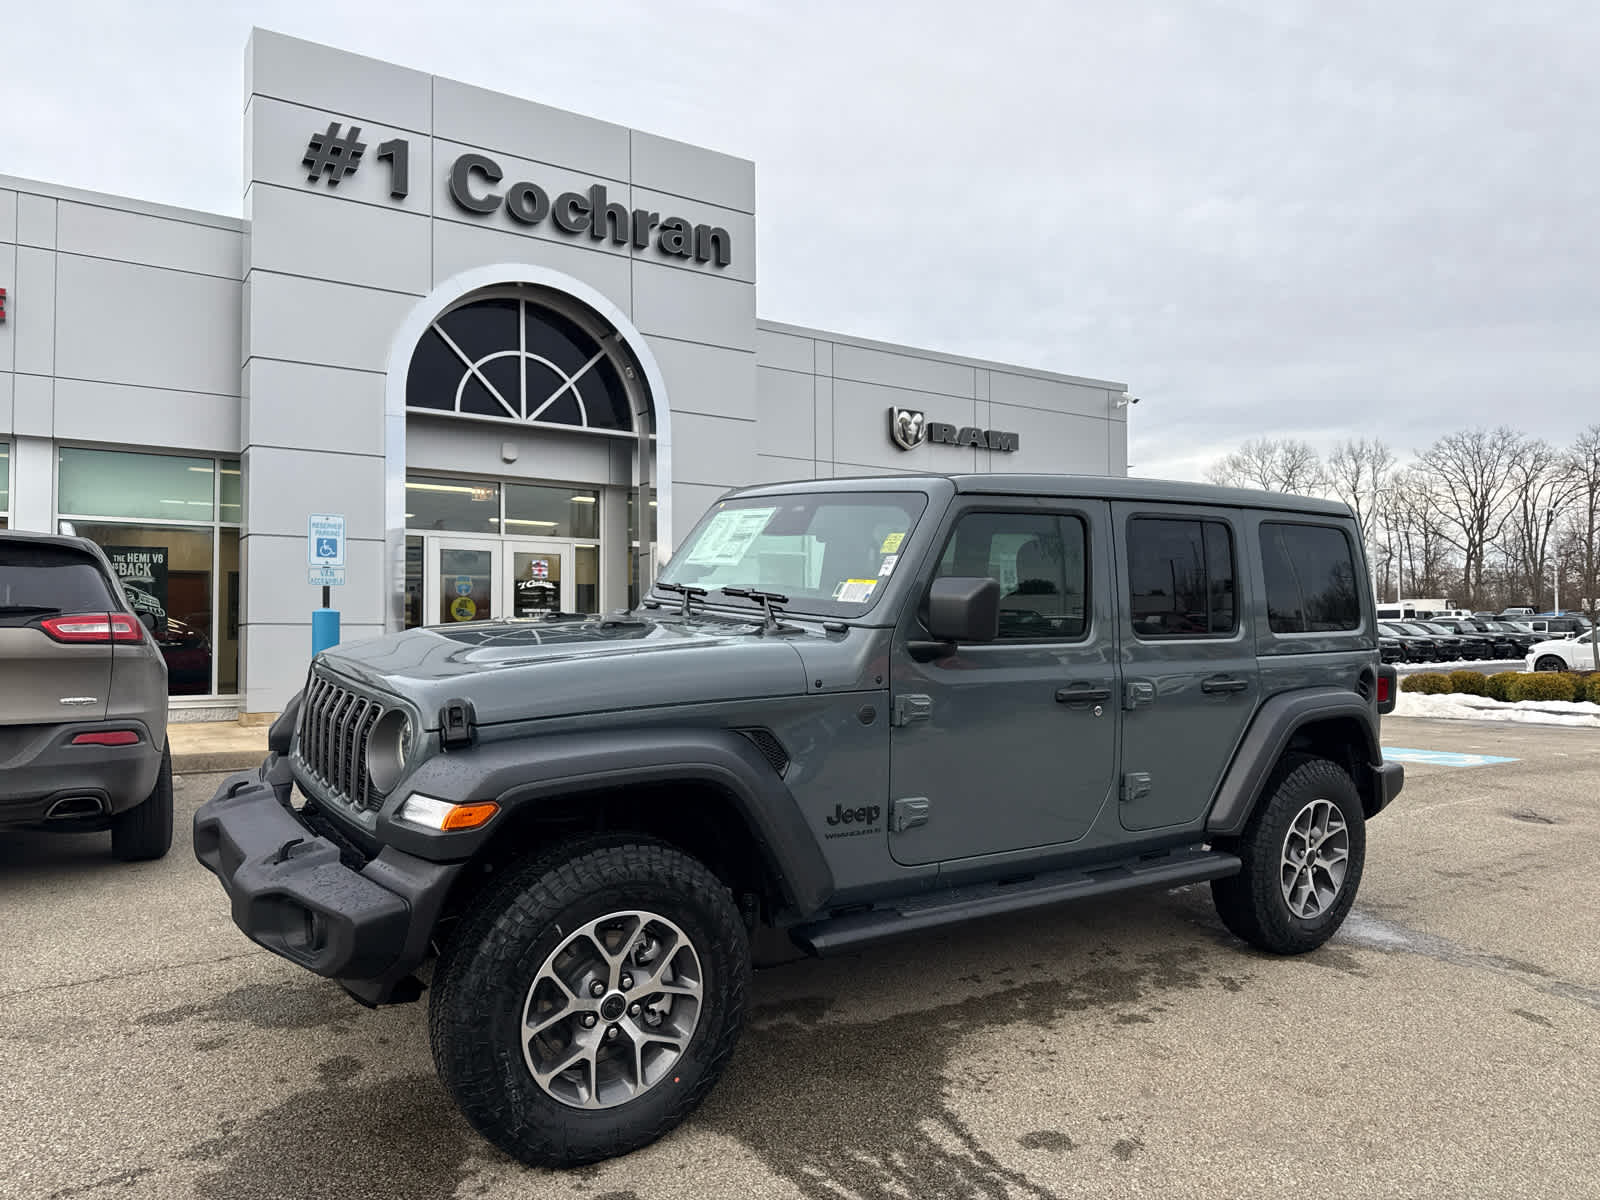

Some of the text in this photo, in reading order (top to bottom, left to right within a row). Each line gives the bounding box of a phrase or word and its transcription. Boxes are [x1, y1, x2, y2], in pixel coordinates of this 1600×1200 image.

[302, 121, 732, 266] #1 Cochran
[927, 422, 1020, 453] RAM
[113, 552, 164, 564] THE HEMI V8
[119, 562, 152, 577] BACK
[825, 803, 881, 827] Jeep
